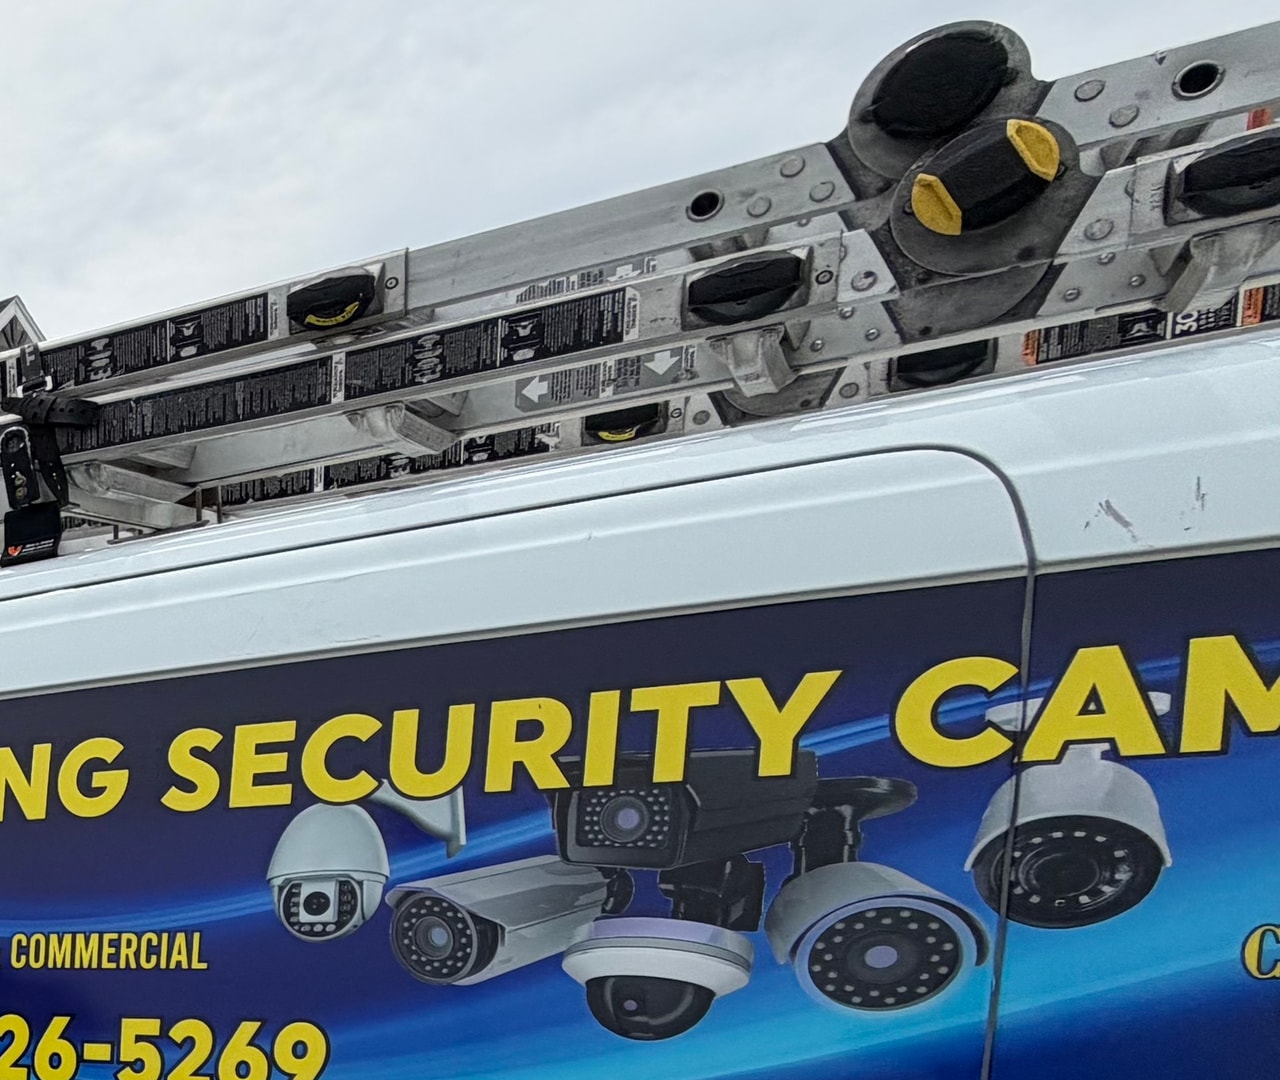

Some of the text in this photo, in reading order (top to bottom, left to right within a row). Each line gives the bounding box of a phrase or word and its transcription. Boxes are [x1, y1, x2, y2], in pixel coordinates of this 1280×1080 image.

[161, 670, 843, 812] SECURITY
[894, 633, 1280, 769] CAM
[10, 932, 208, 970] COMMERCIAL
